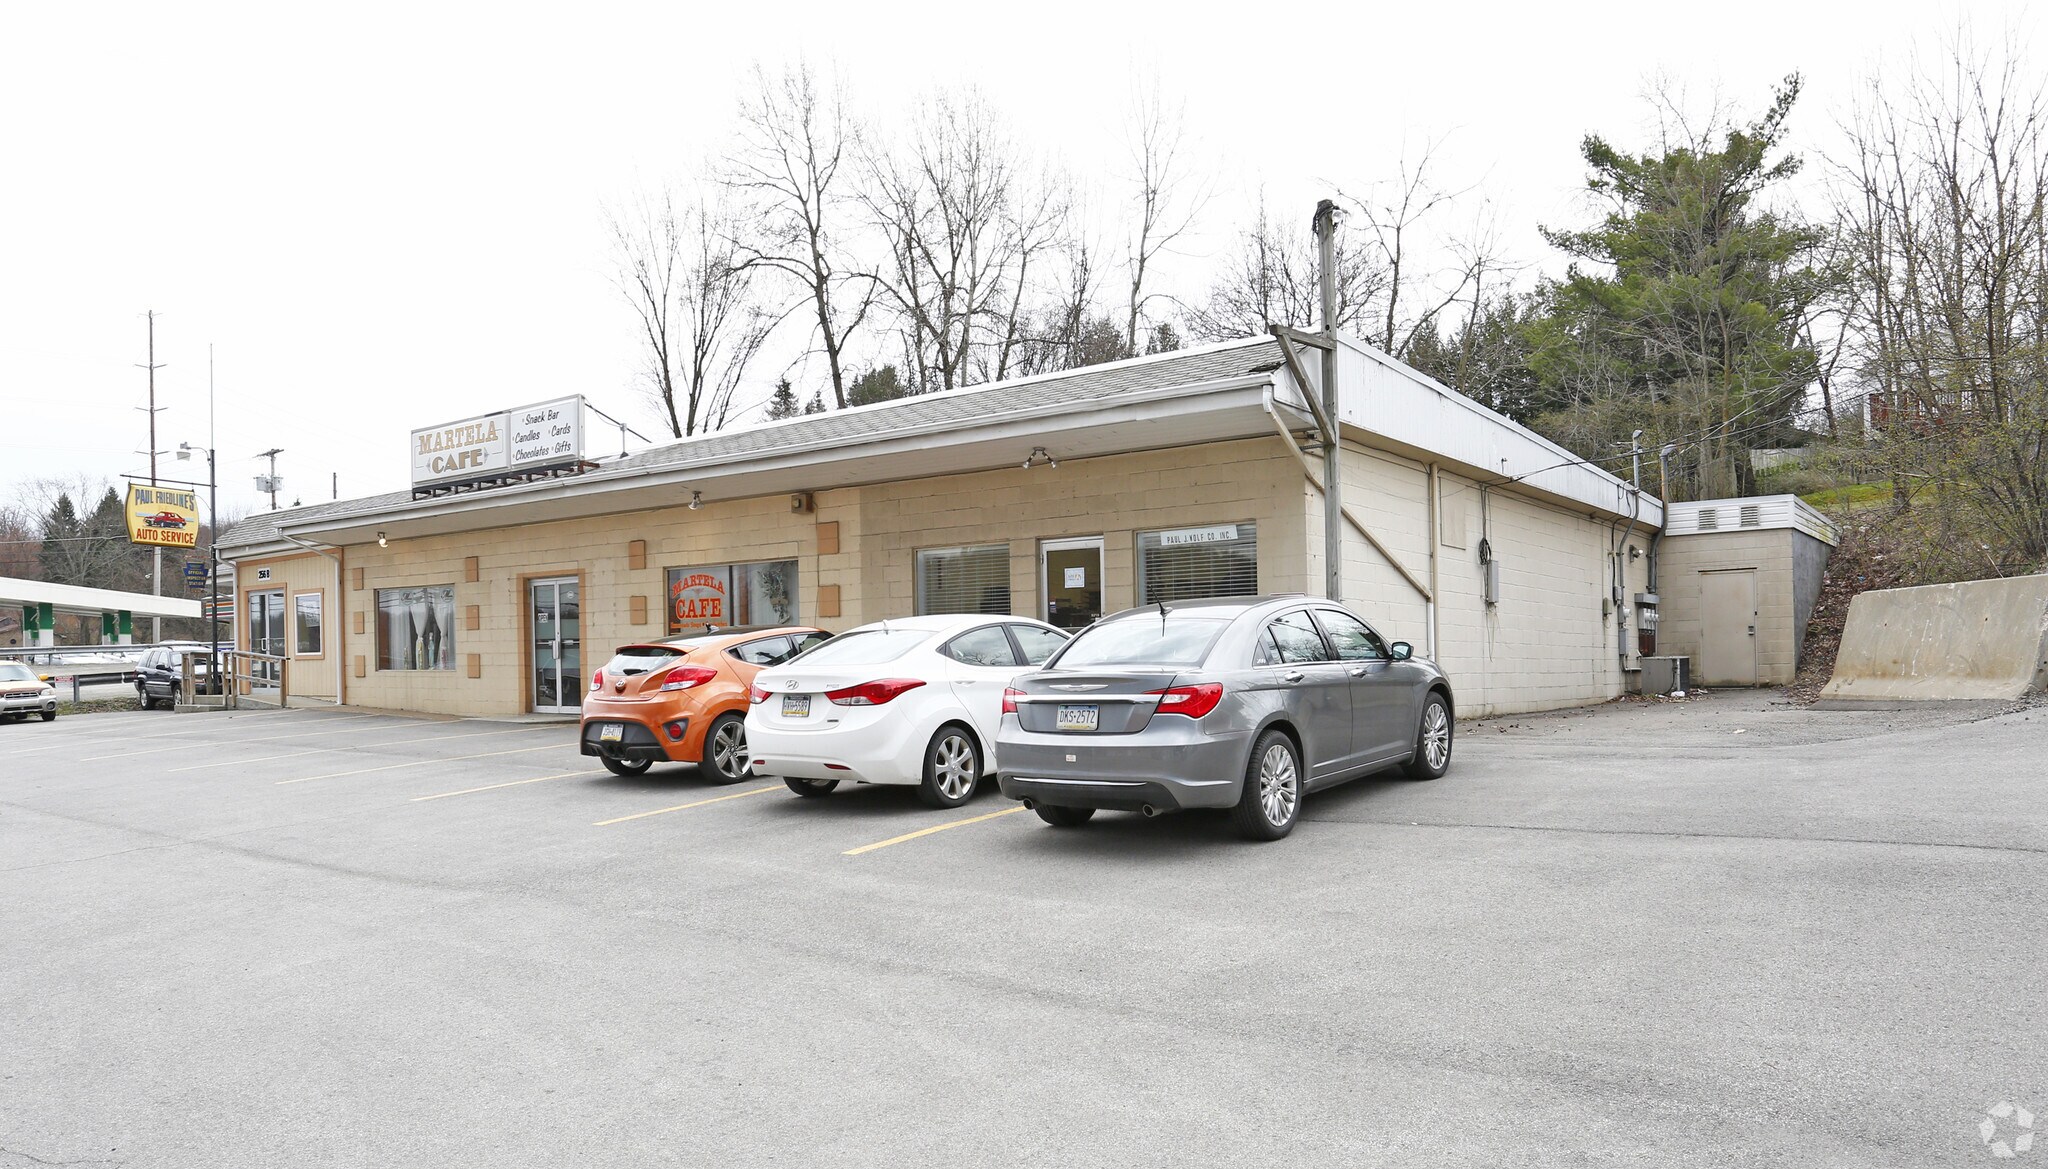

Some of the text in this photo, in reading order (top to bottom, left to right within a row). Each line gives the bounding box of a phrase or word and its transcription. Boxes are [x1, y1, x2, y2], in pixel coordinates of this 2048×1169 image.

[525, 409, 560, 425] Snack Bar
[418, 420, 498, 455] MARTELA
[515, 423, 571, 444] Candles Cards
[431, 448, 483, 474] CAFE
[515, 440, 571, 461] Chocolates Gifts
[135, 489, 154, 506] PAUL
[136, 528, 194, 544] AUTO SERVICE
[1166, 536, 1181, 544] PAUL
[672, 574, 726, 598] MARTELA
[676, 597, 721, 620] CAFE
